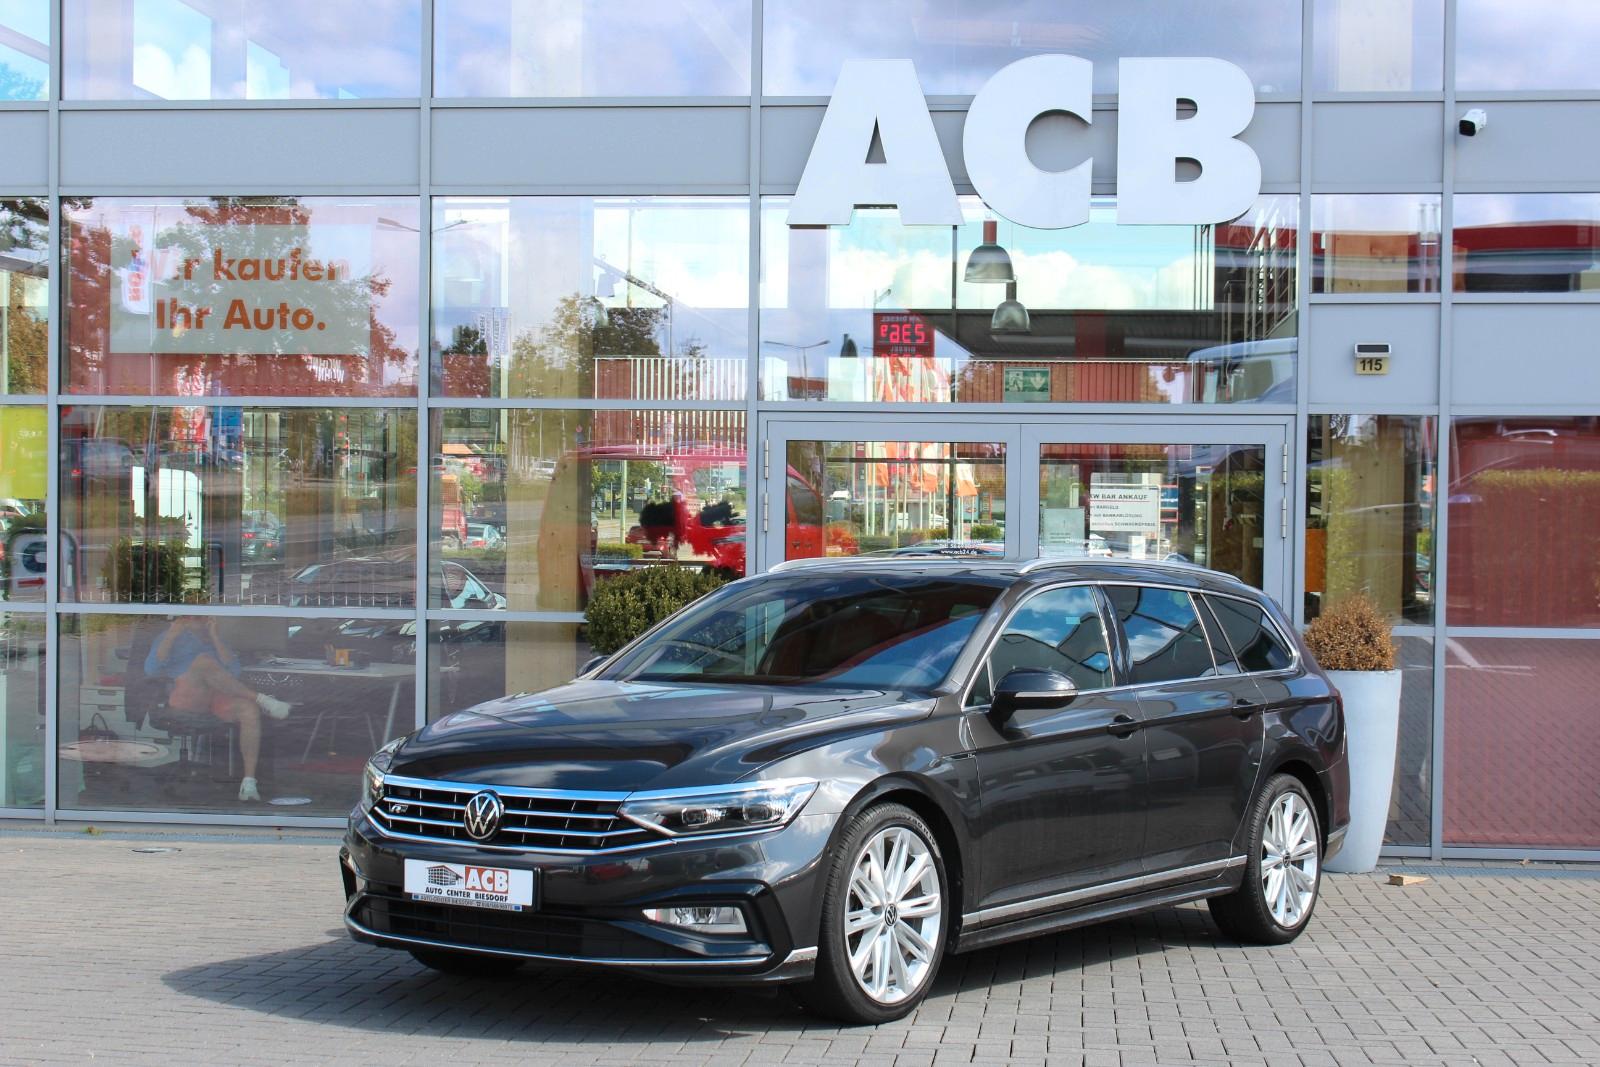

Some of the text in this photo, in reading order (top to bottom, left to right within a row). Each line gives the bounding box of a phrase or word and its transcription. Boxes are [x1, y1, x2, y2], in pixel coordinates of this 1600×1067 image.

[786, 54, 1262, 229] ACB
[213, 247, 350, 281] kaufen
[156, 297, 327, 331] Ihr Auto.
[1360, 359, 1383, 371] 115
[425, 886, 509, 902] AUTO CENTER BIESDORF
[466, 868, 508, 893] ACB
